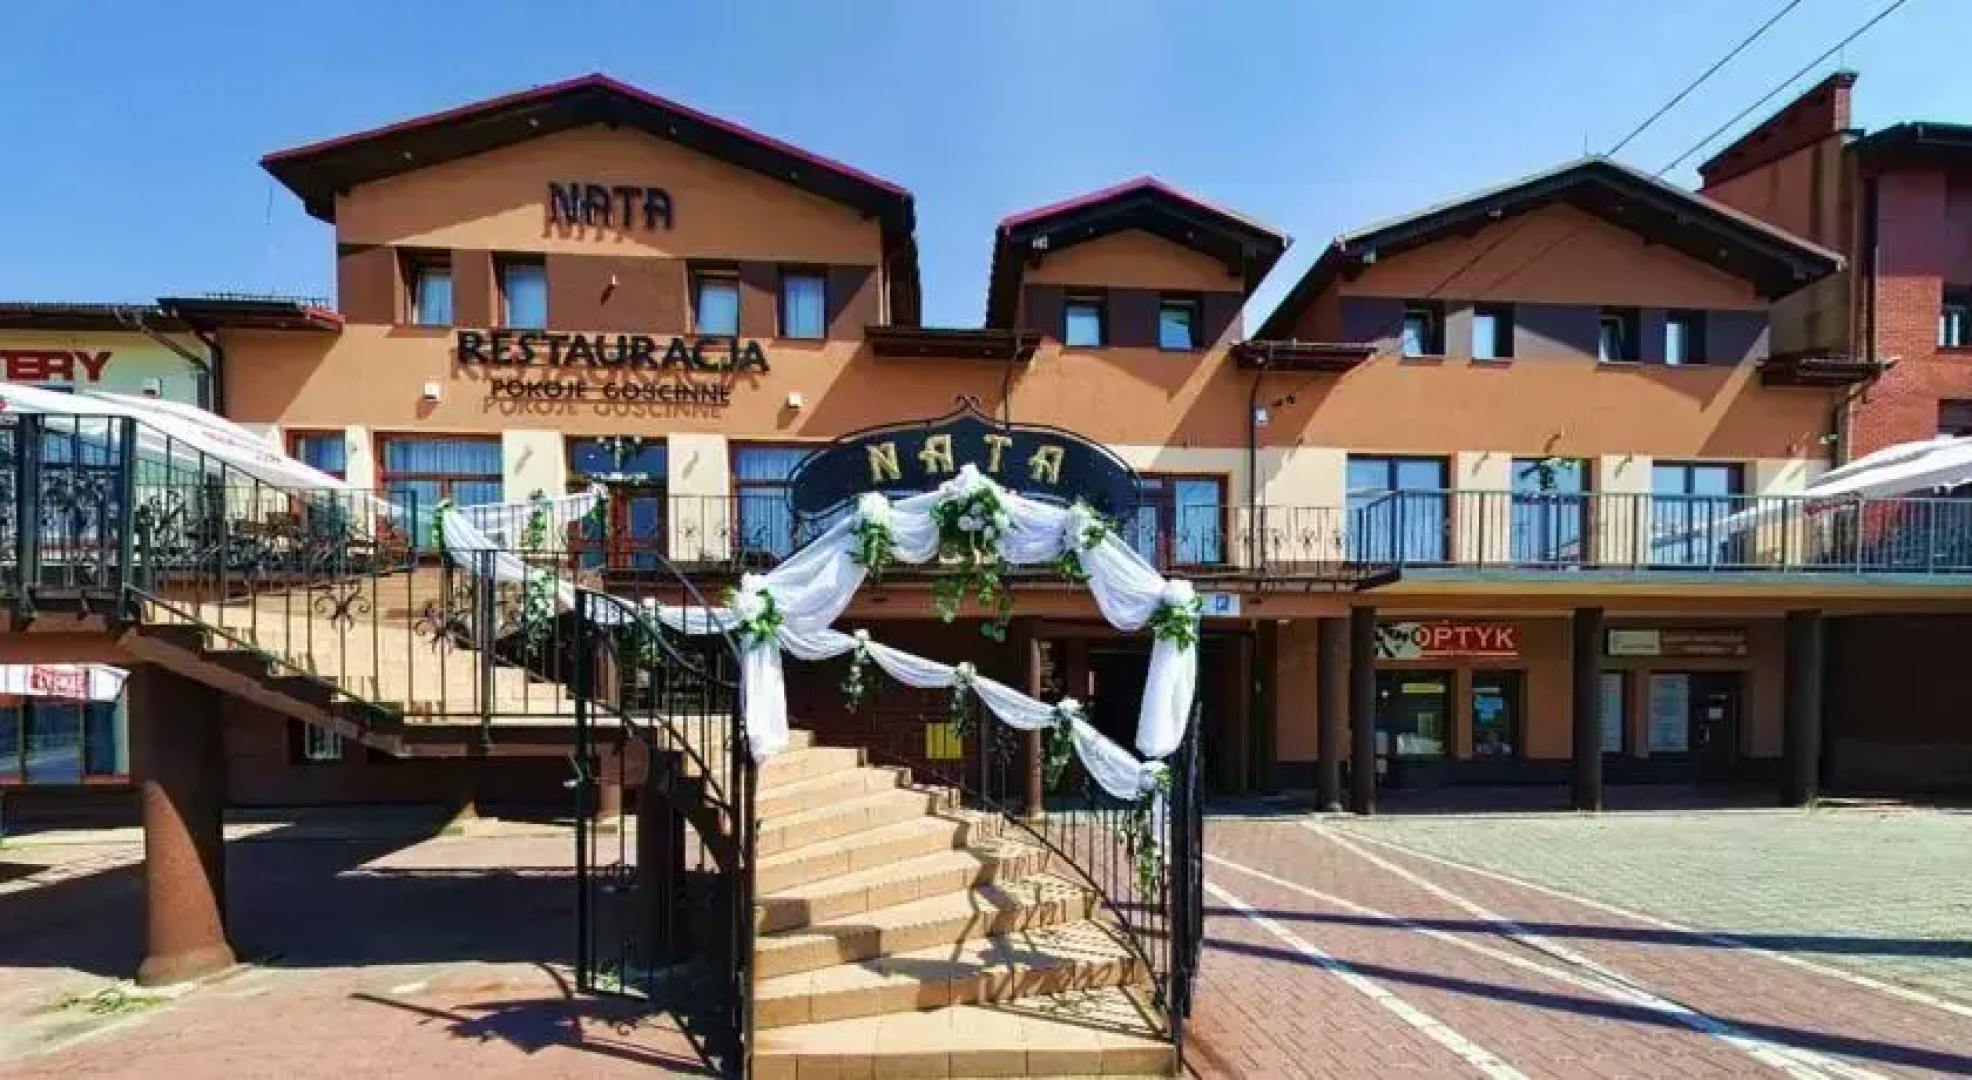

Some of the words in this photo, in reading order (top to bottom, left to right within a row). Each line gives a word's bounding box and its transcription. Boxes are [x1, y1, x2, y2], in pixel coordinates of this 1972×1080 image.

[547, 181, 674, 230] NATA
[456, 330, 770, 371] RESTAURACJA
[491, 379, 586, 398] POKOJE
[866, 433, 1064, 484] NATA
[1410, 626, 1513, 649] OPTYK
